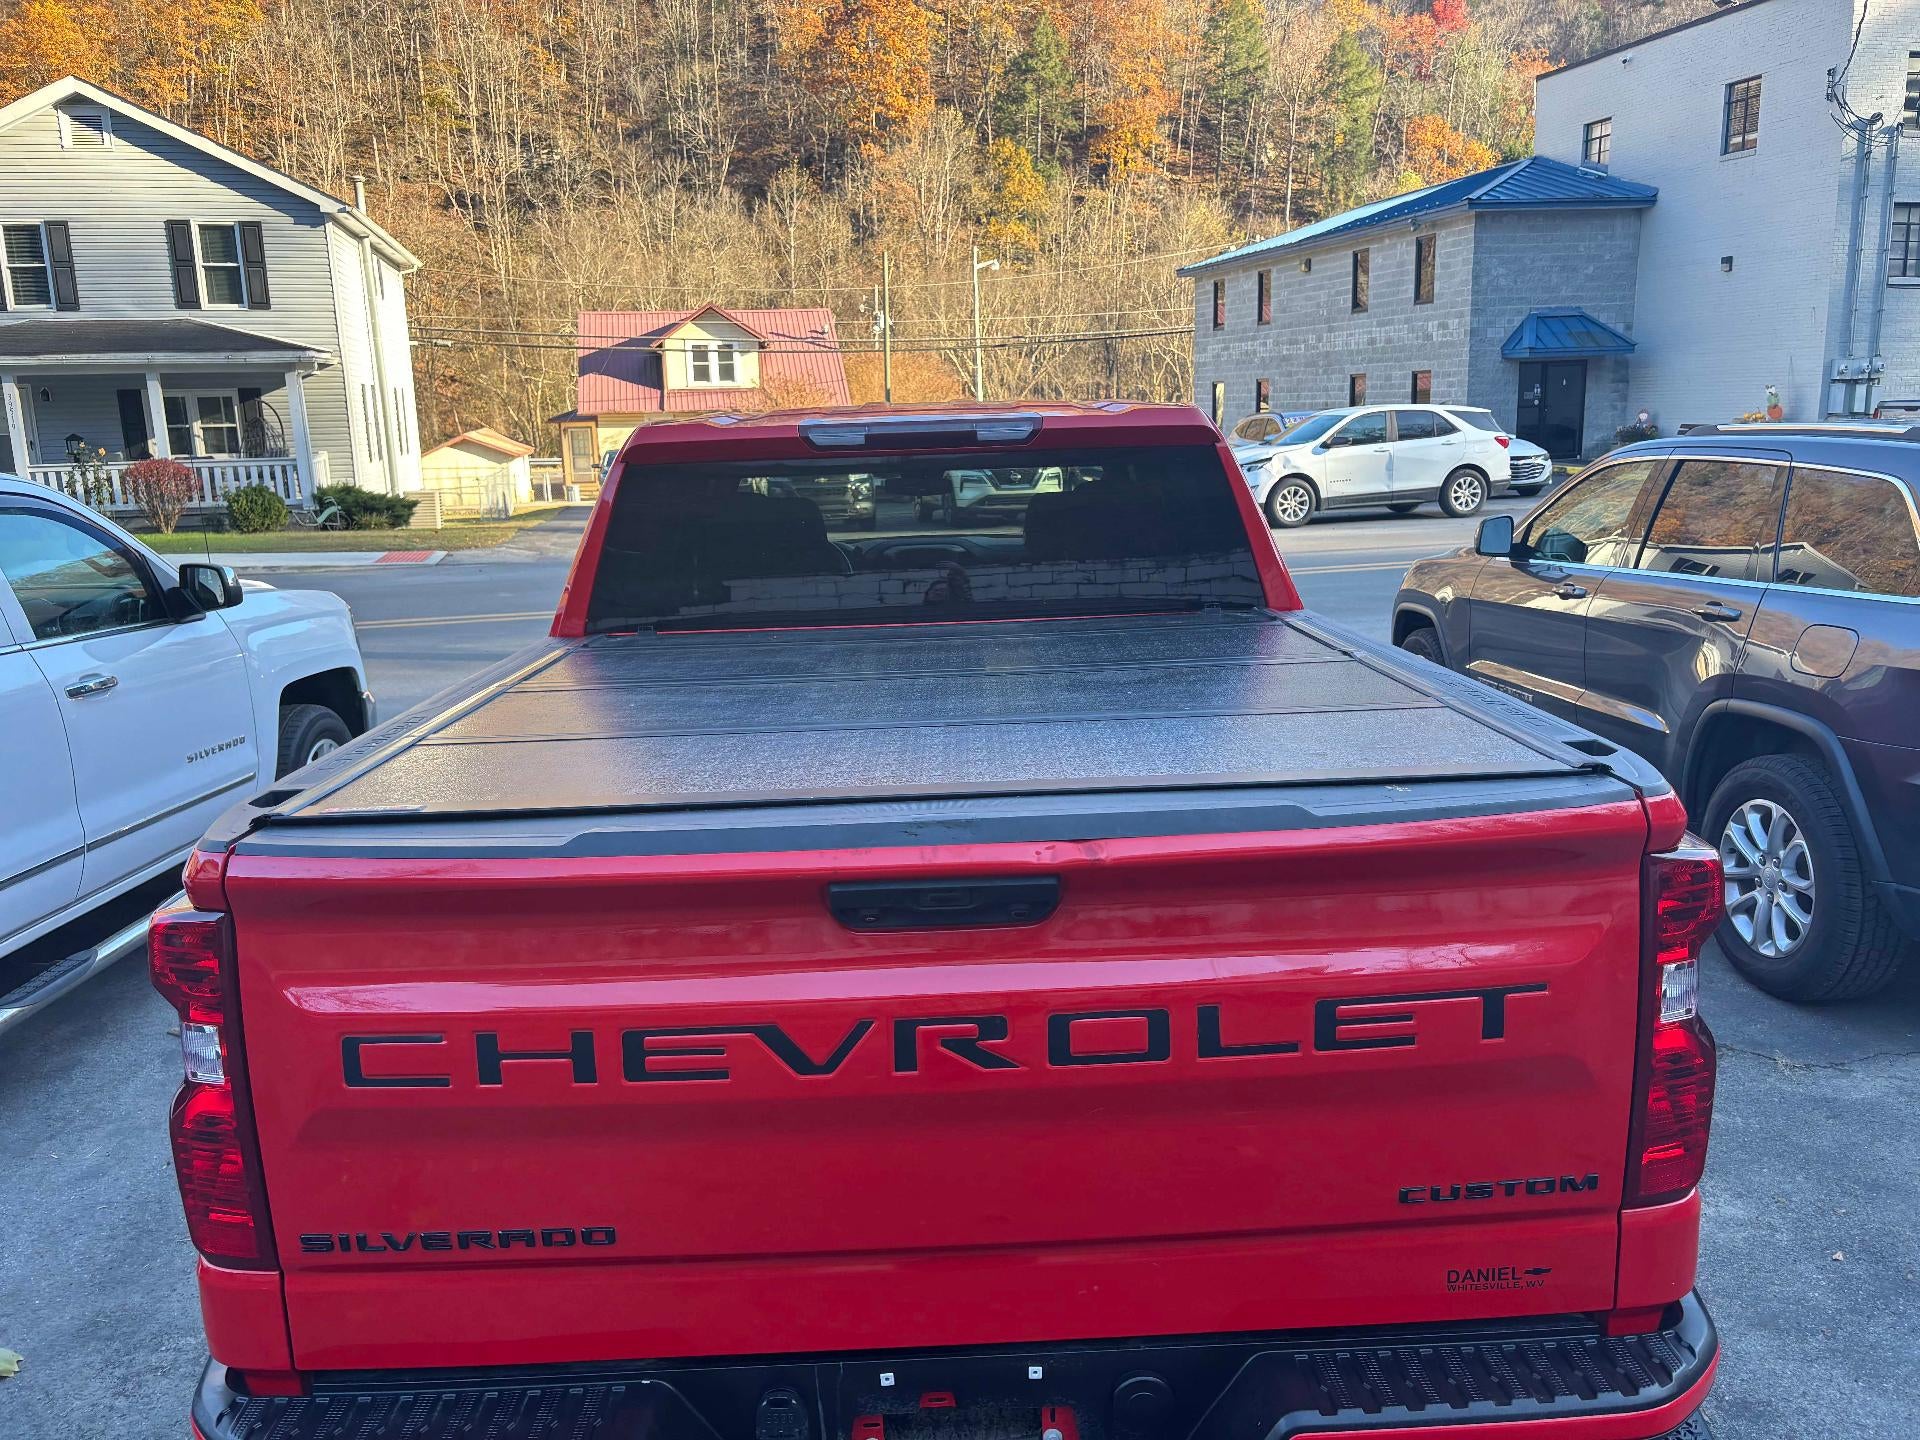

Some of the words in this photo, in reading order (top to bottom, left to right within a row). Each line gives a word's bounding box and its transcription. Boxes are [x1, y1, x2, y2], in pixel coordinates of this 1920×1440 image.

[186, 735, 246, 764] SILVERADO
[342, 982, 1548, 1087] CHEVROLET
[1398, 1173, 1599, 1204] CUSTOM
[299, 1226, 616, 1252] SILVERADO
[1446, 1266, 1522, 1284] DANIEL
